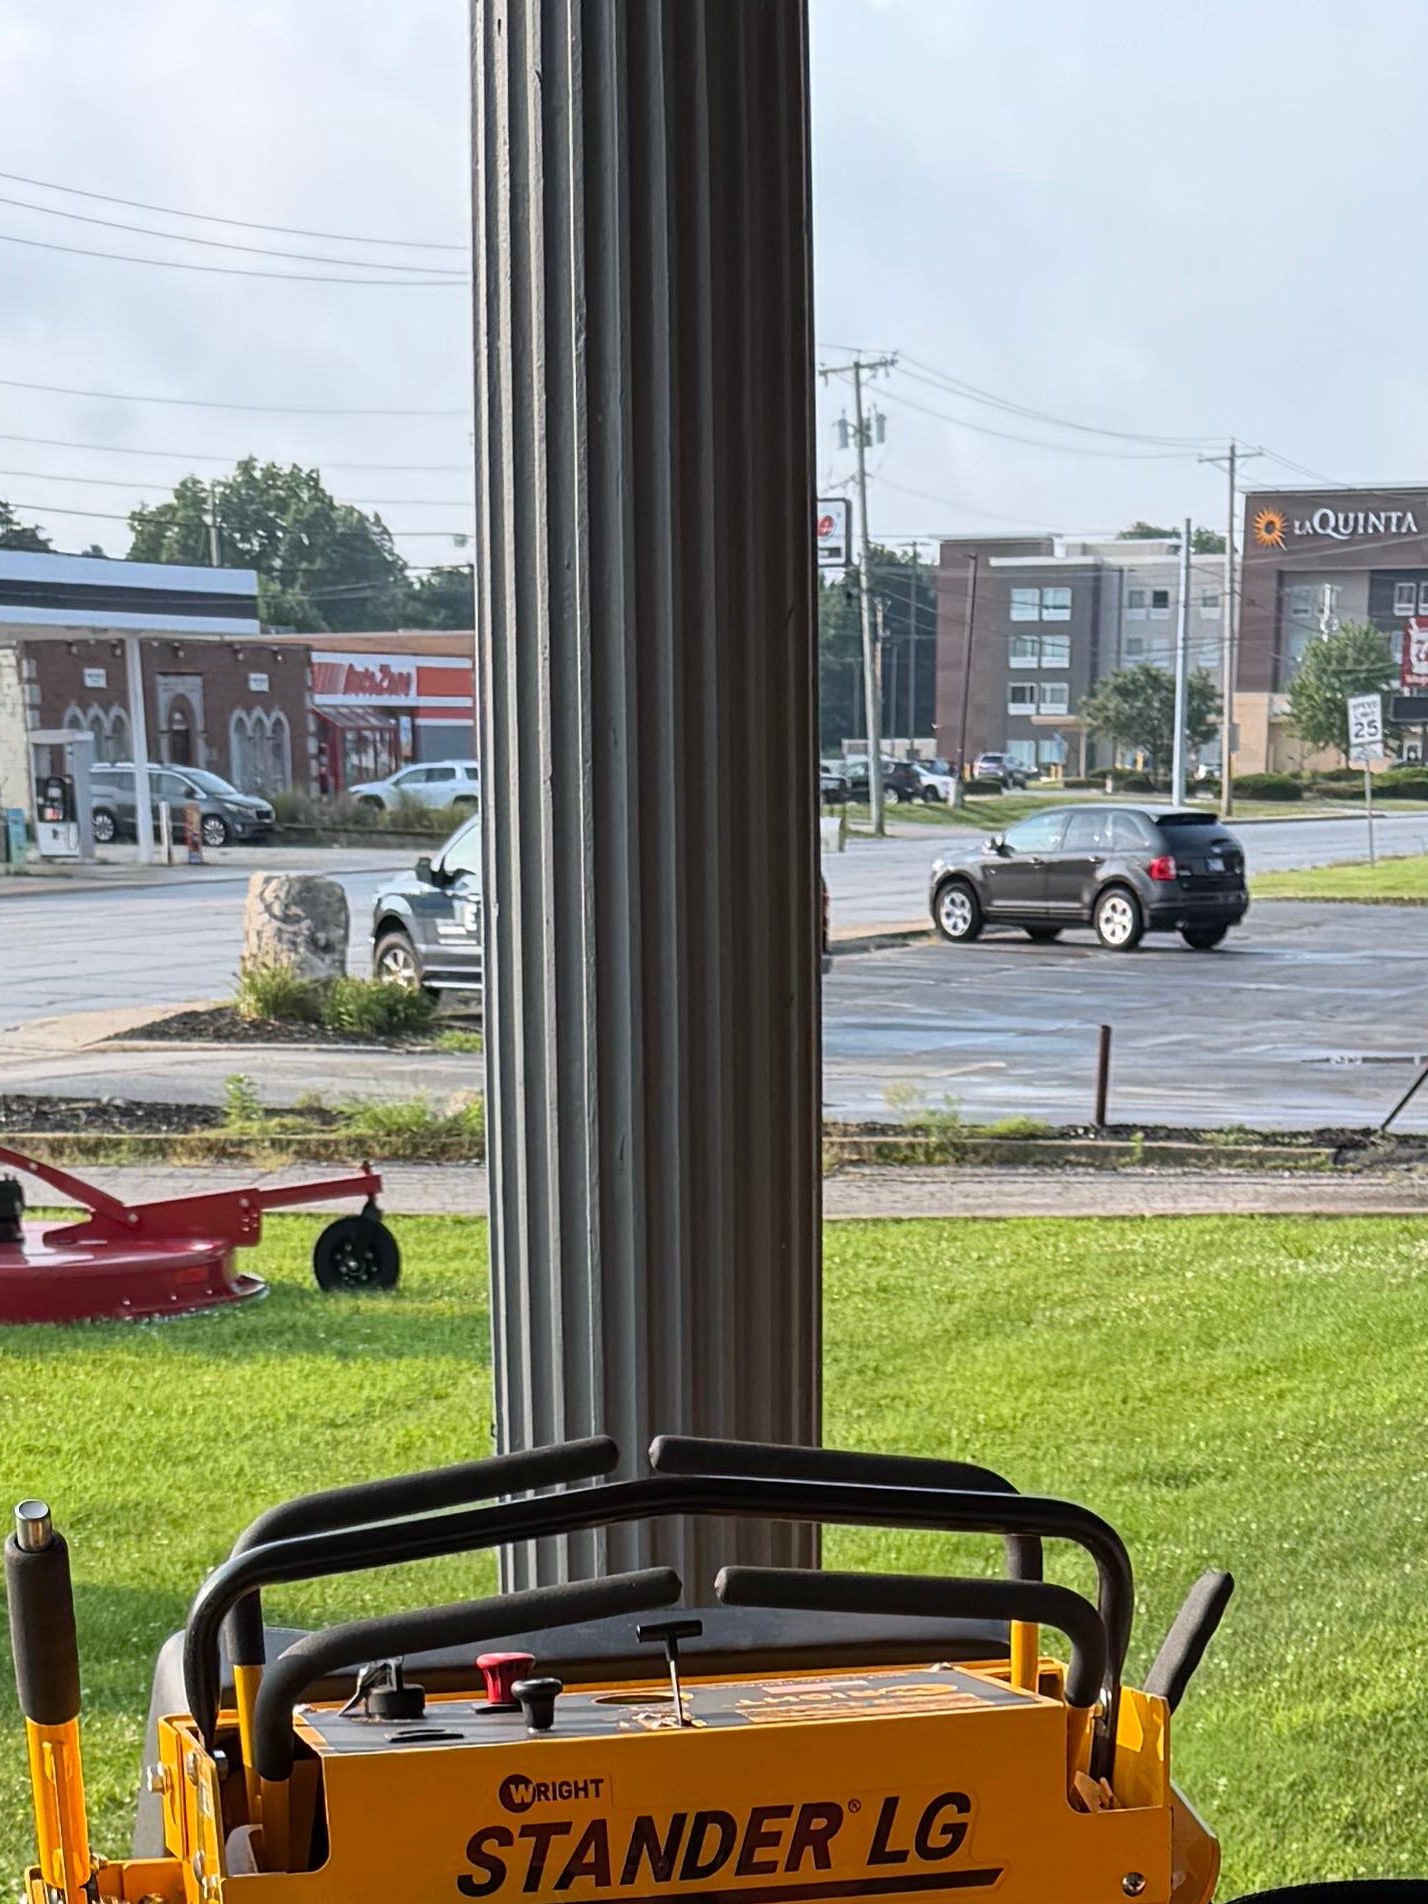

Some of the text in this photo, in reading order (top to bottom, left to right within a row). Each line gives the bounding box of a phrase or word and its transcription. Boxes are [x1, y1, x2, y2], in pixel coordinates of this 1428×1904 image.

[1312, 507, 1419, 541] QUINTA
[1354, 719, 1379, 739] 25
[499, 1774, 605, 1813] WRIGHT
[866, 1791, 972, 1866] LG
